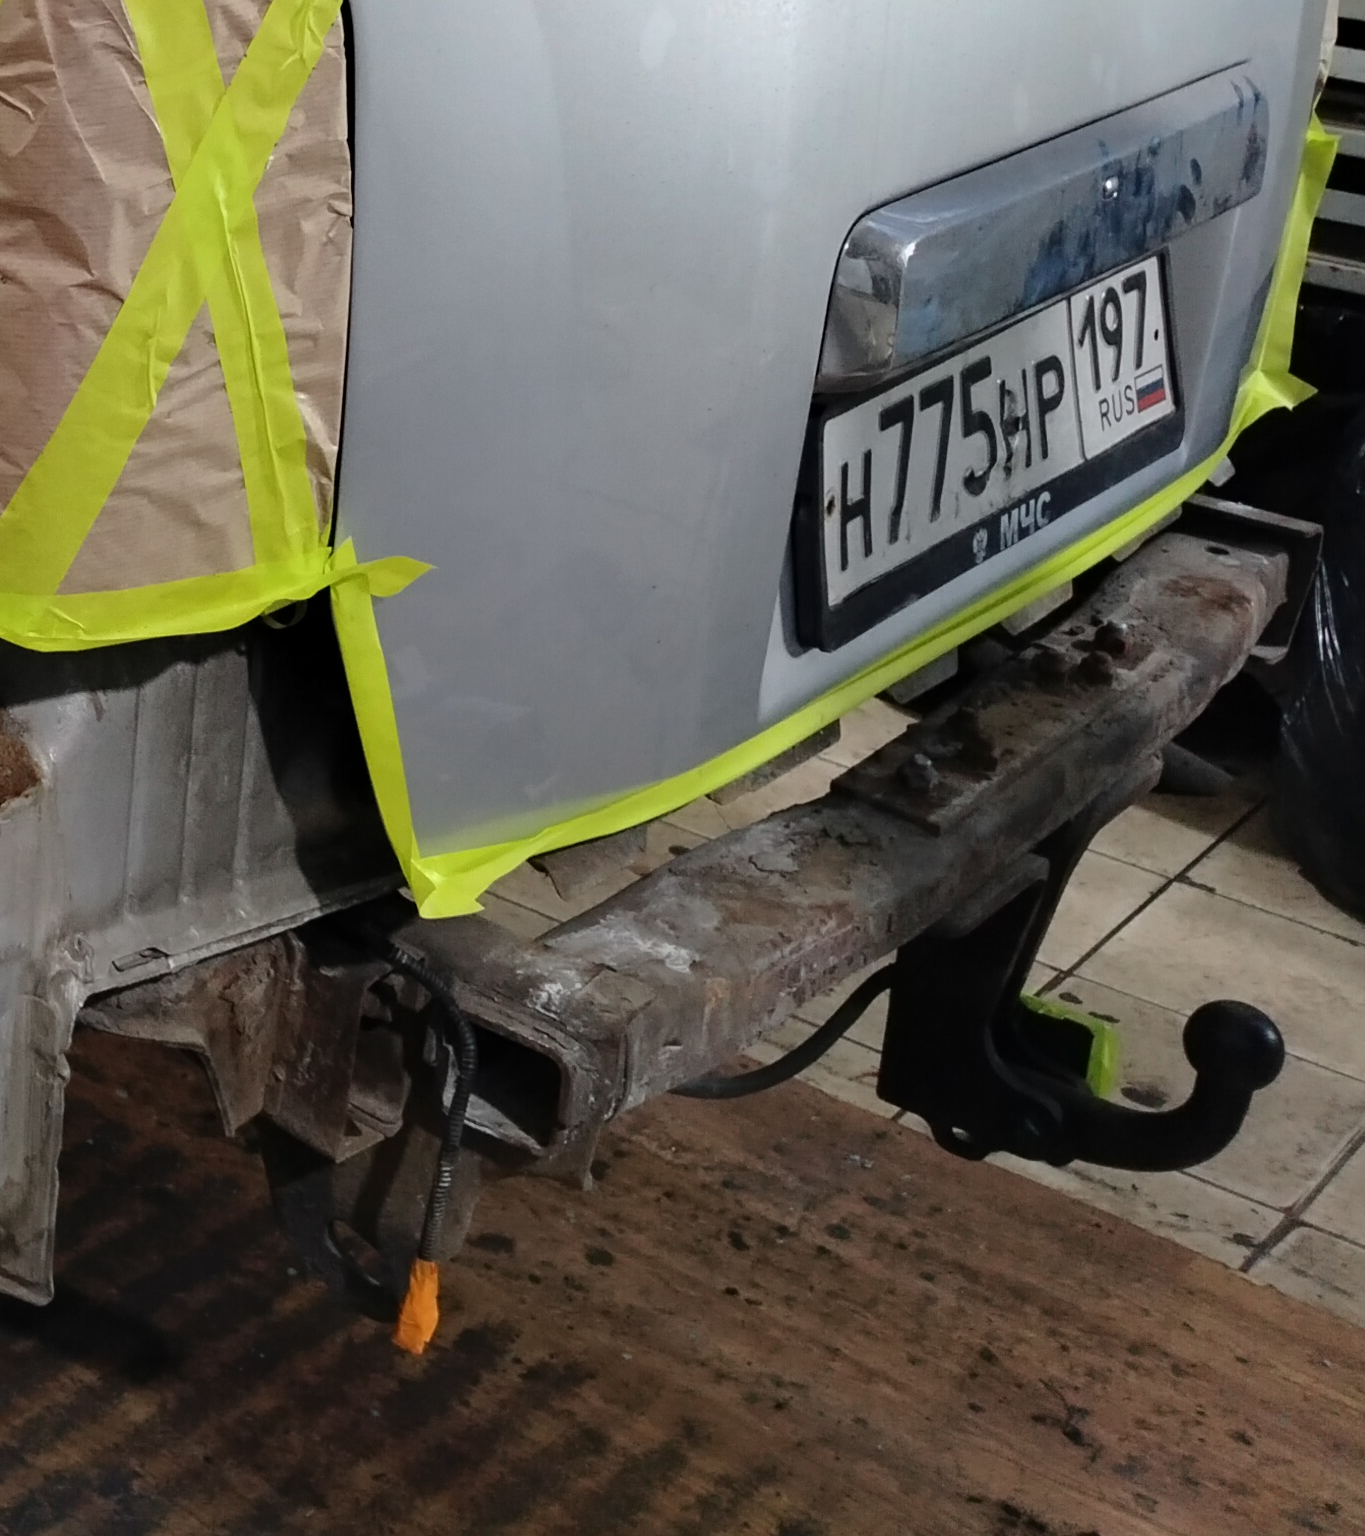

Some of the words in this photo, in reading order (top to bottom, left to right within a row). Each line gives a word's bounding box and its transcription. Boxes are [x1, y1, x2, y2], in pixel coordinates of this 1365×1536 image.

[1077, 269, 1148, 393] 197
[1098, 384, 1136, 432] RUS
[999, 490, 1053, 552] МЧС
